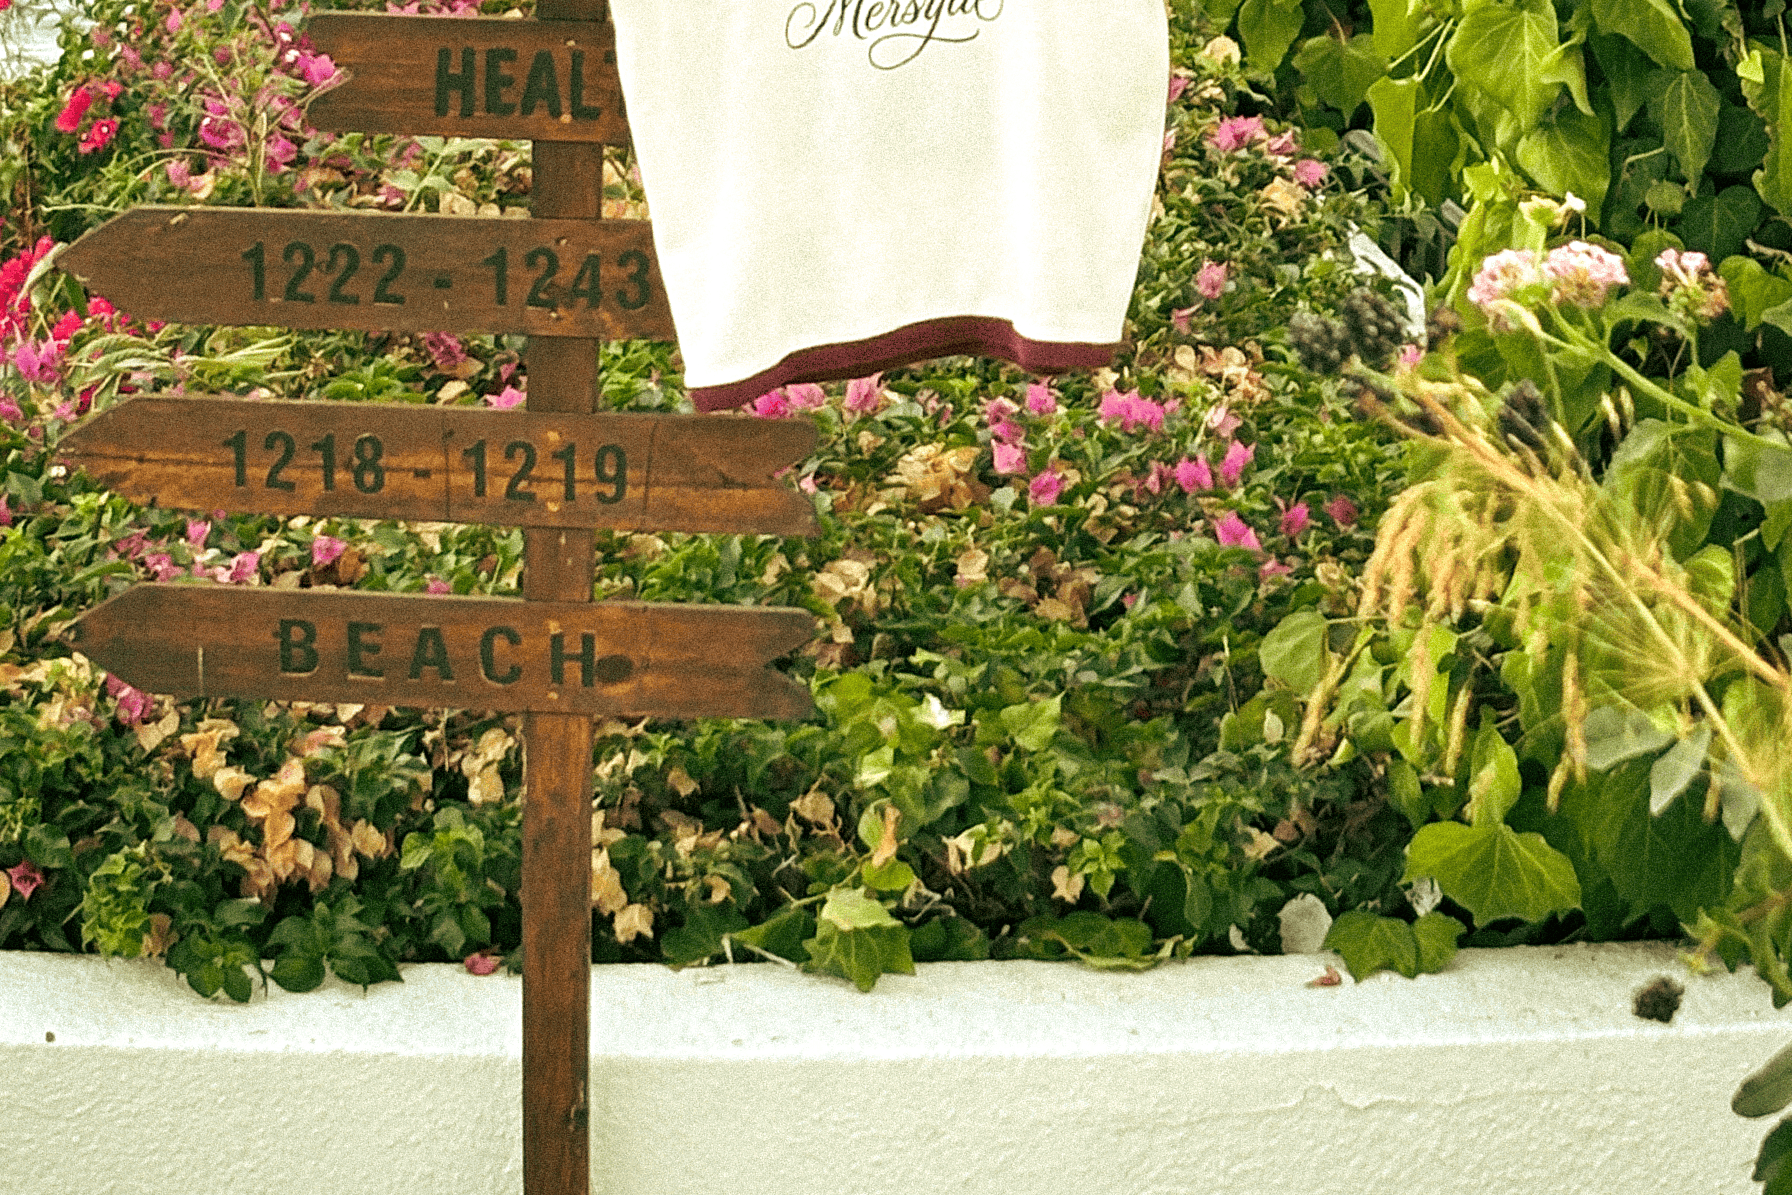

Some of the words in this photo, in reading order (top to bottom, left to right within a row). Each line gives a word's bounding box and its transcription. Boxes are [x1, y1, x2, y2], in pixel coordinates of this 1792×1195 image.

[434, 46, 626, 121] HEAL
[241, 241, 406, 305] 1222
[482, 246, 651, 310] 1243
[222, 429, 386, 495] 1218
[462, 438, 628, 505] 1219
[278, 618, 596, 689] BEACH
